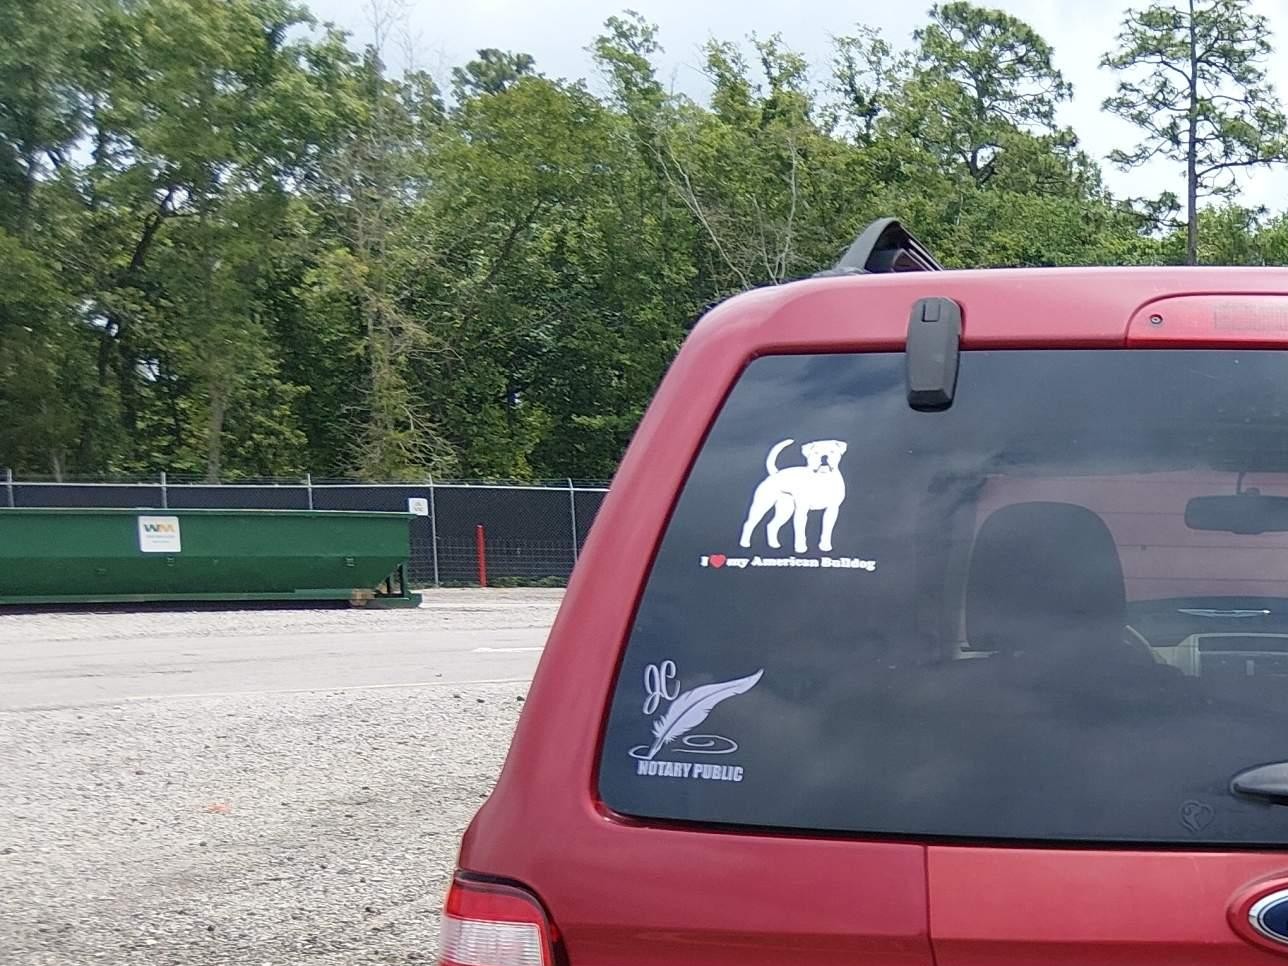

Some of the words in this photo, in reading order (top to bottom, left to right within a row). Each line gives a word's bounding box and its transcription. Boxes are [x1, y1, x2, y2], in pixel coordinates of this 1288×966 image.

[144, 524, 177, 533] WM
[700, 556, 710, 567] I
[726, 557, 750, 569] my
[751, 556, 819, 568] American
[820, 557, 876, 571] Bulldog
[637, 760, 692, 777] NOTARY
[692, 763, 744, 782] PUBLIC
